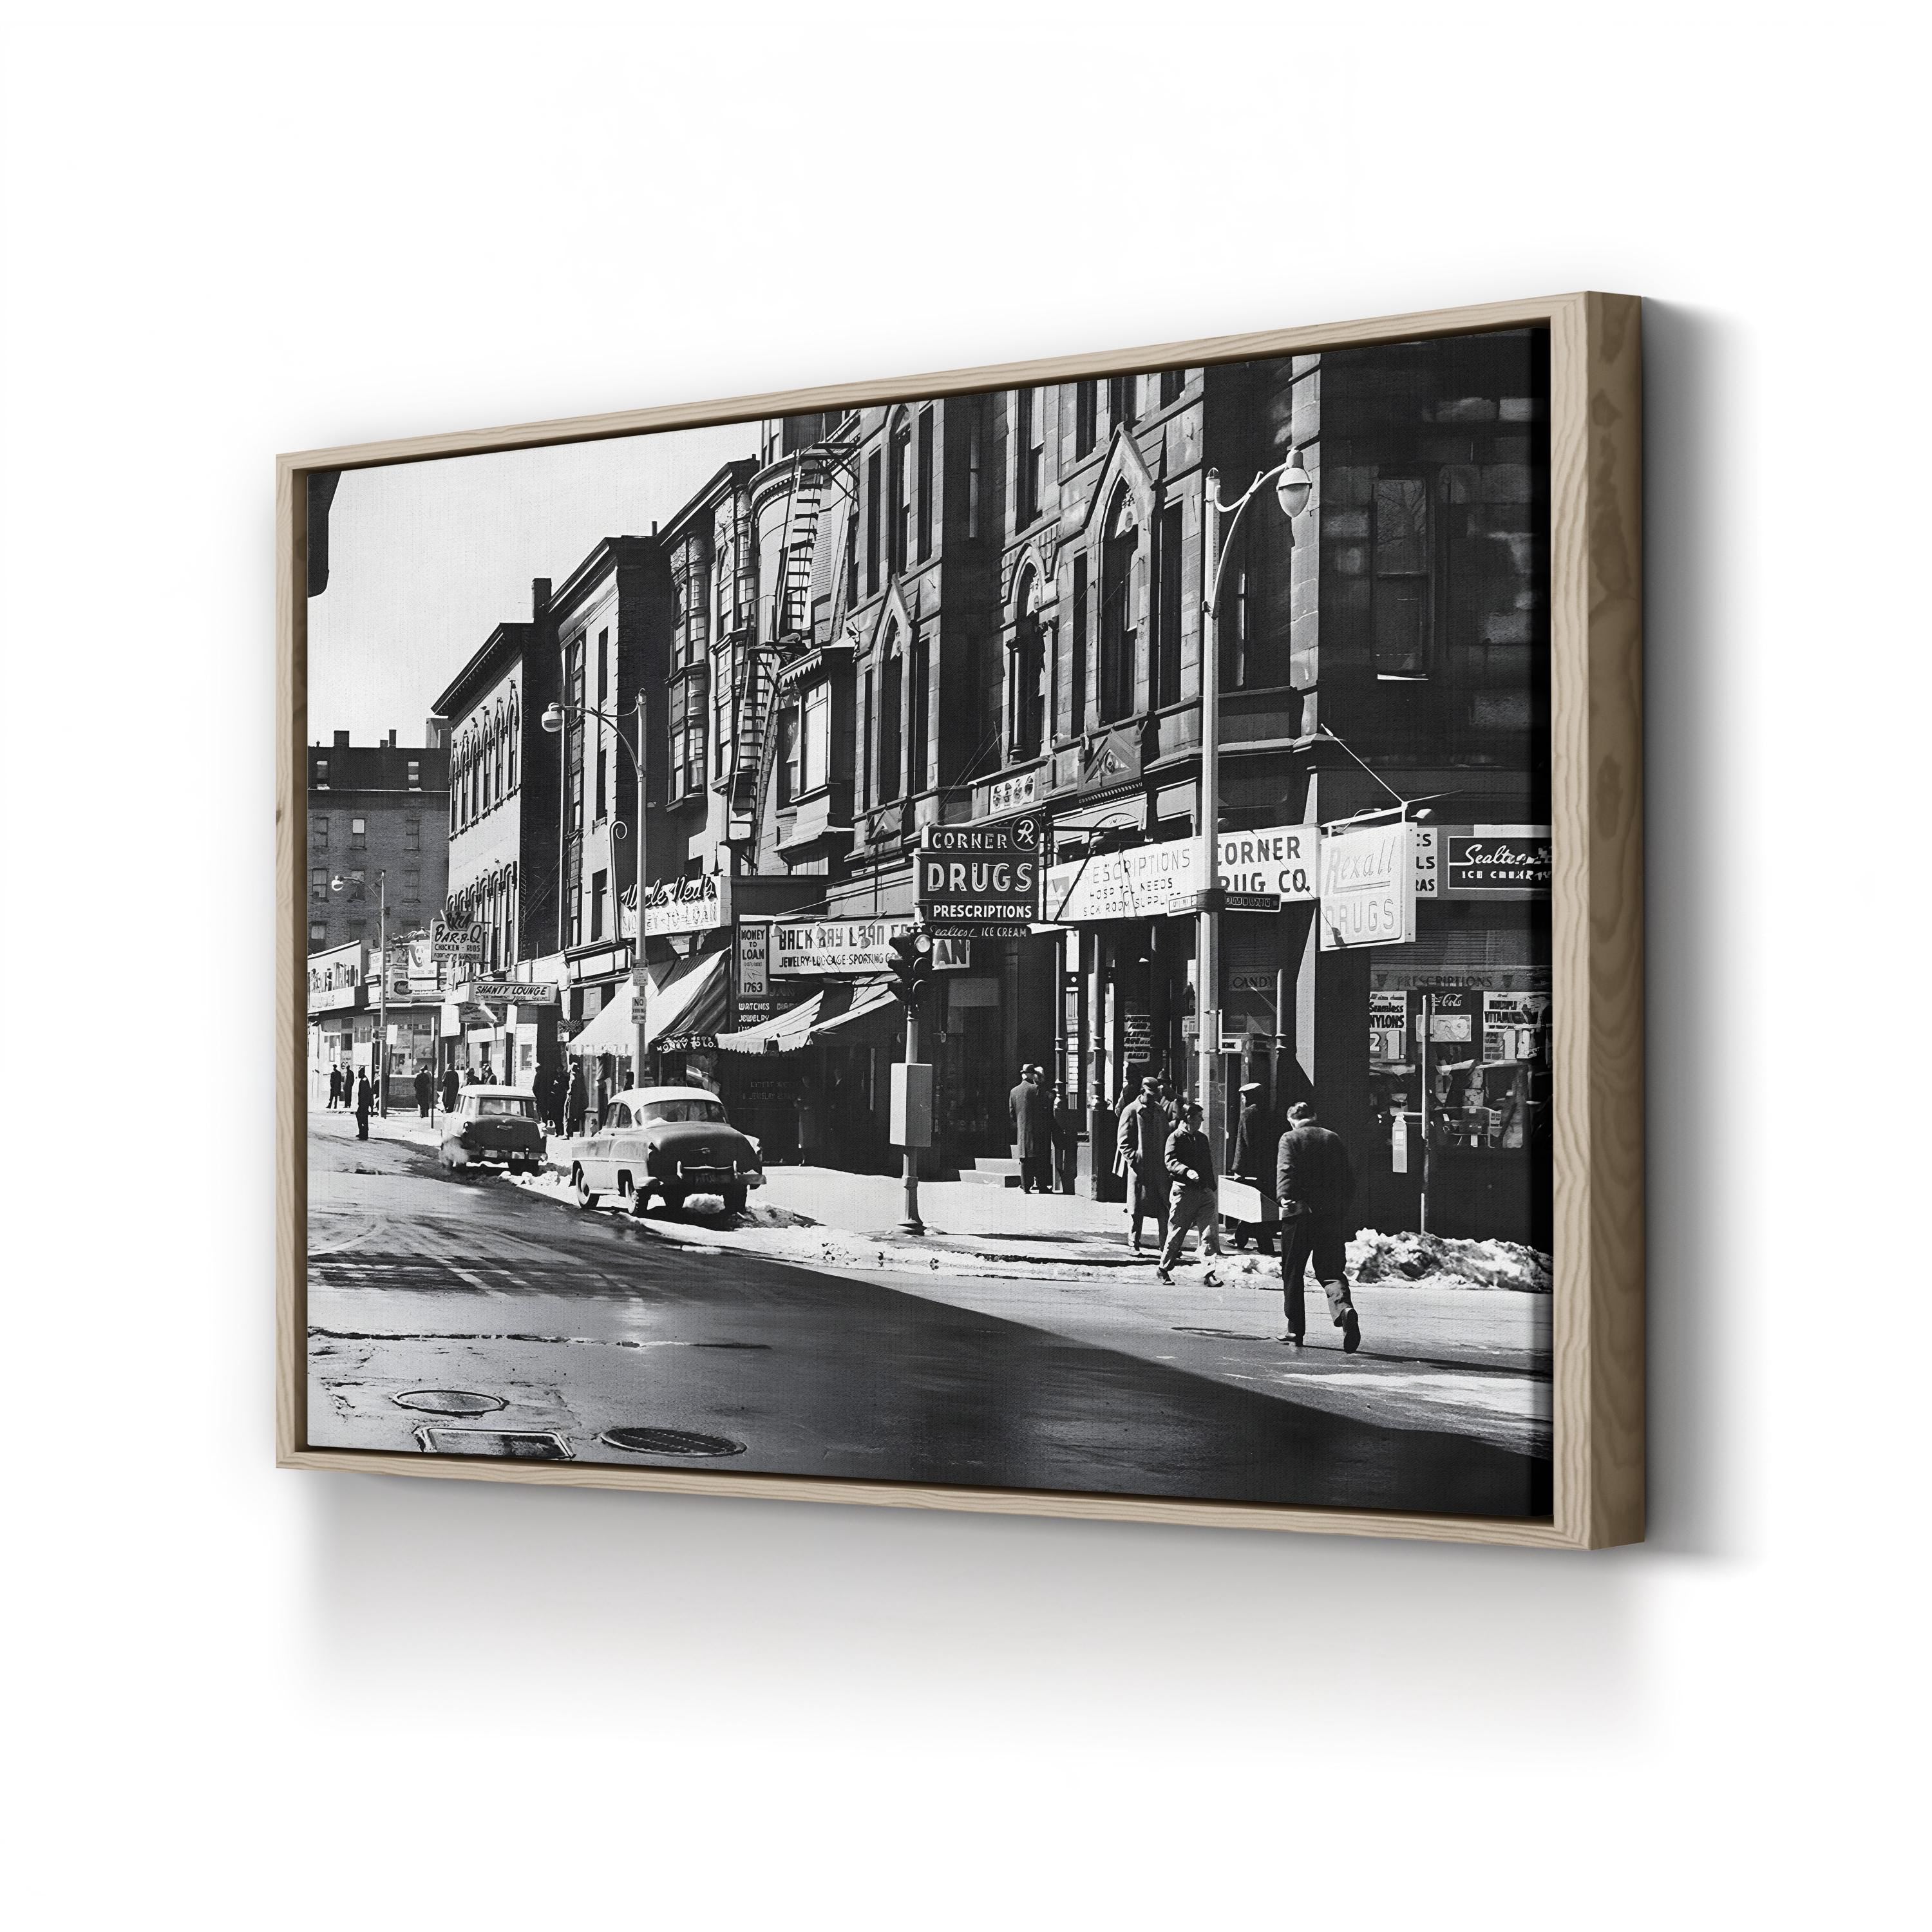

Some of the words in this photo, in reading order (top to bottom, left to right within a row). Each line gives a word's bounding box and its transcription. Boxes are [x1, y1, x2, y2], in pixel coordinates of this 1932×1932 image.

[933, 833, 1008, 849] CORNER
[1324, 836, 1396, 896] Rexall
[927, 862, 1032, 892] DRUGS
[1217, 872, 1266, 893] RUG
[1278, 868, 1311, 893] CO.
[933, 905, 1032, 918] PRESCRIPTIONS
[1325, 898, 1394, 936] DRUGS
[434, 923, 483, 944] BAR-B-Q
[741, 929, 765, 940] MONEY
[981, 927, 994, 936] ICE
[997, 927, 1027, 937] CREAM
[779, 929, 813, 951] BACK
[742, 949, 764, 960] LOAN
[475, 985, 511, 995] SHANTY
[512, 986, 547, 996] LOUNGE
[744, 982, 762, 993] 1763
[634, 998, 644, 1007] NO
